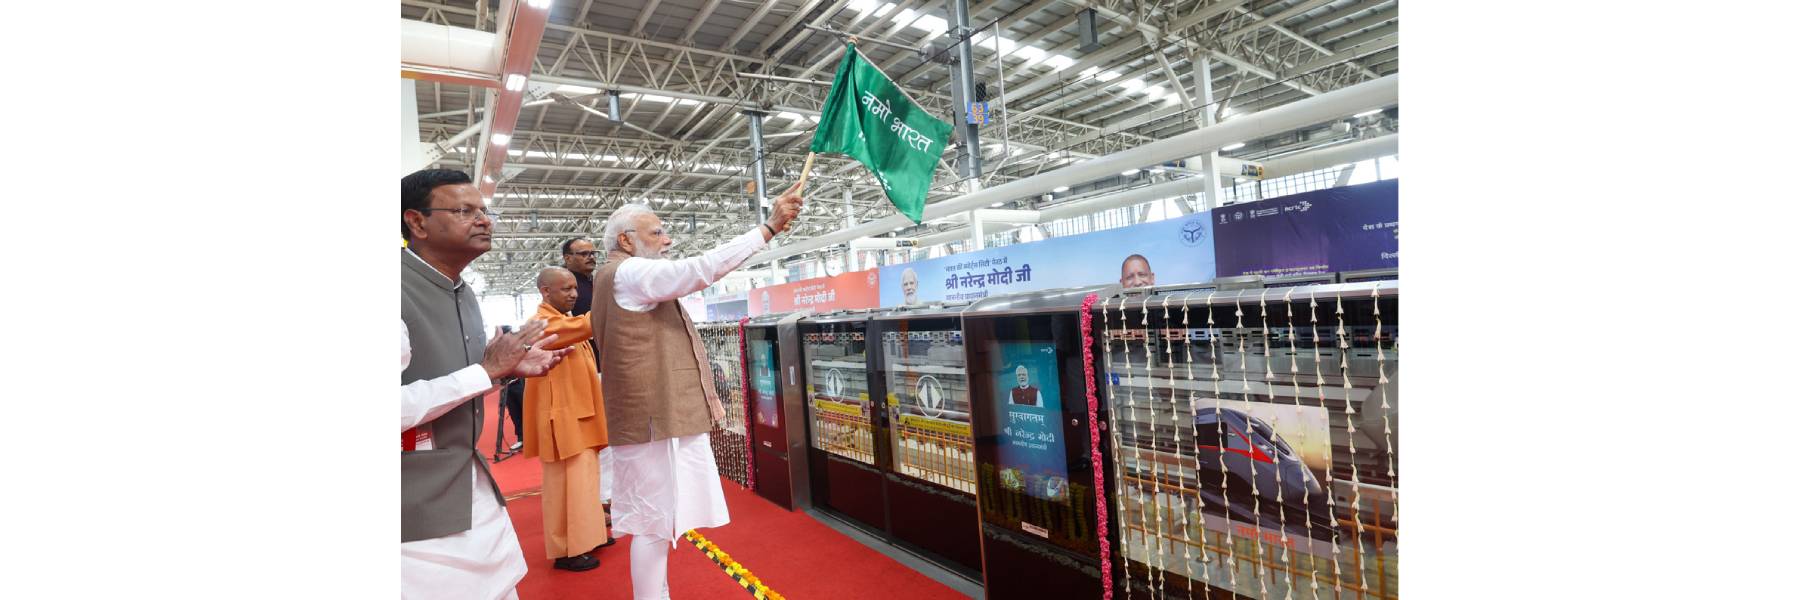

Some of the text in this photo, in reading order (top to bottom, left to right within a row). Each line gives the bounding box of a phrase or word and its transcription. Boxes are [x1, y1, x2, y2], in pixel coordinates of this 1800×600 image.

[862, 91, 933, 152] नमो भारत
[945, 264, 1031, 289] श्री नरेन्द्र मोदी जी
